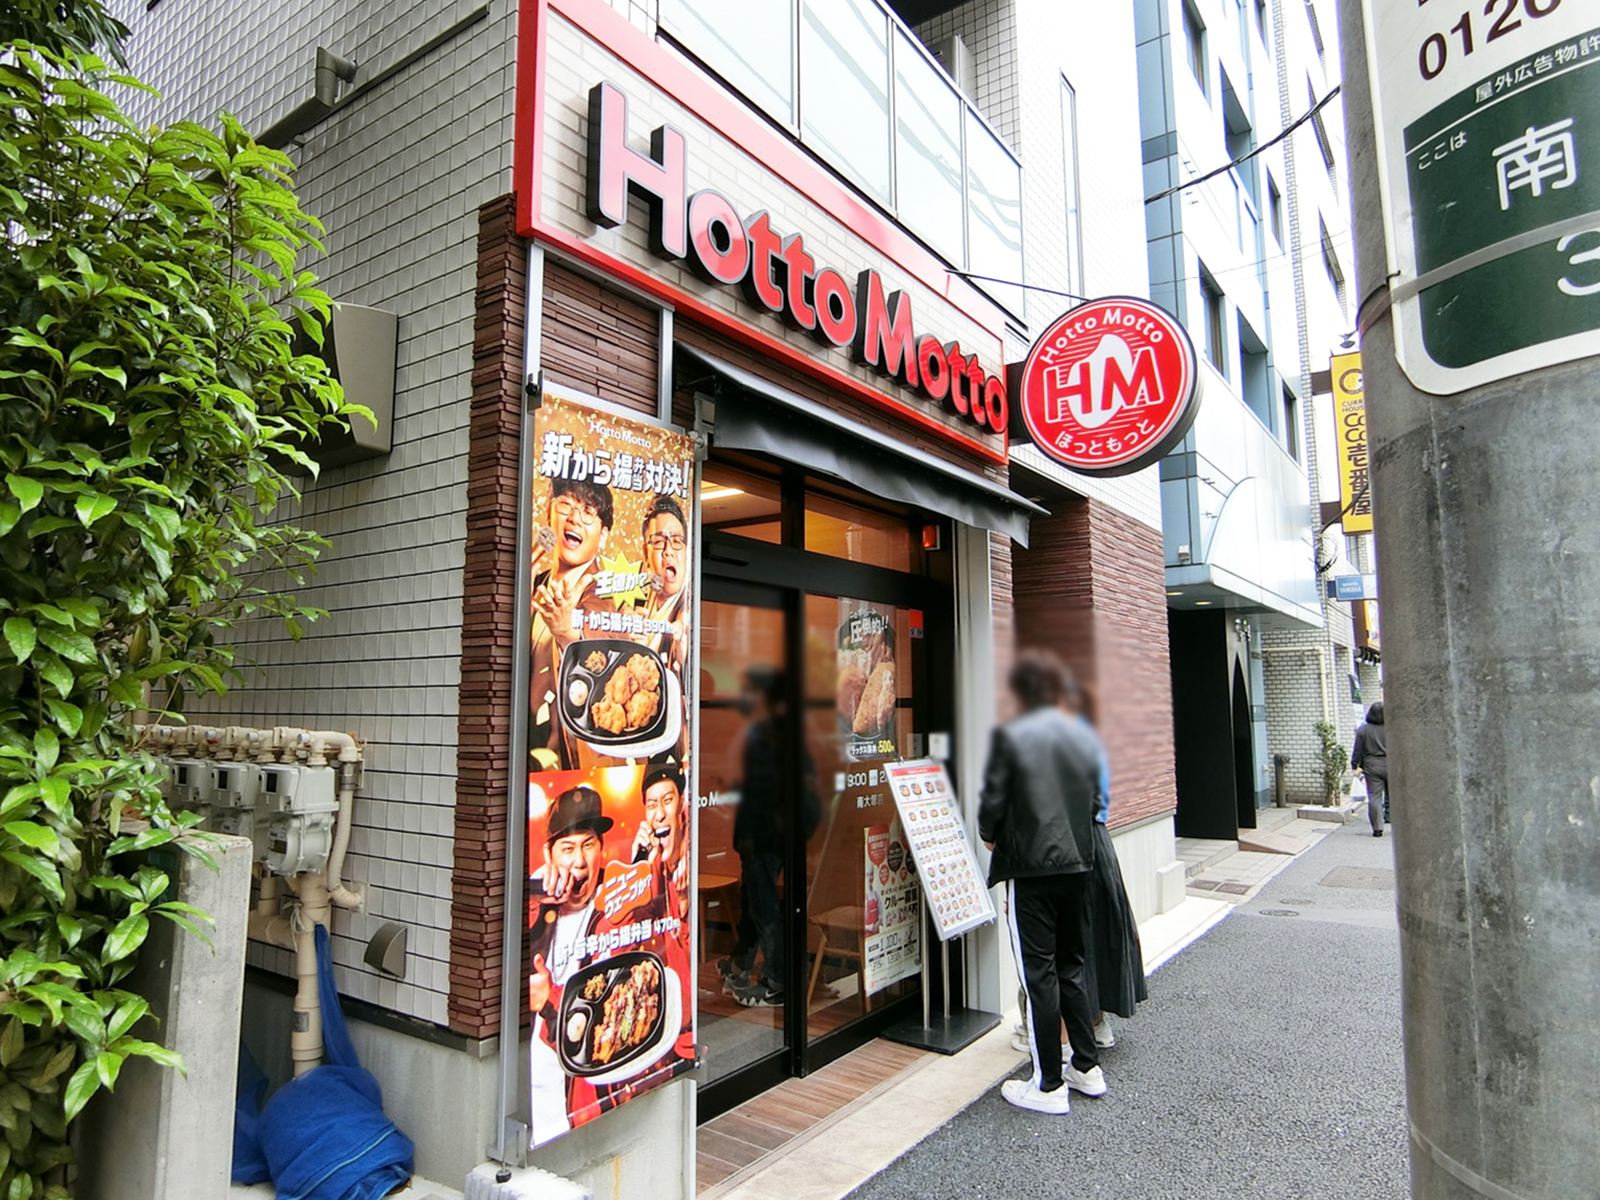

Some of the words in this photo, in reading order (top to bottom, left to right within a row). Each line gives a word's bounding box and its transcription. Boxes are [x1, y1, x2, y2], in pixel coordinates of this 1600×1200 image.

[1417, 131, 1467, 170] ここは
[1491, 117, 1578, 211] 南
[588, 80, 857, 348] Hotto
[854, 268, 1009, 434] Motto
[1040, 317, 1097, 364] Hotto
[1102, 308, 1163, 343] Motto
[590, 420, 621, 440] Hotto
[621, 430, 652, 450] Motto
[1055, 419, 1155, 455] ほっともっと
